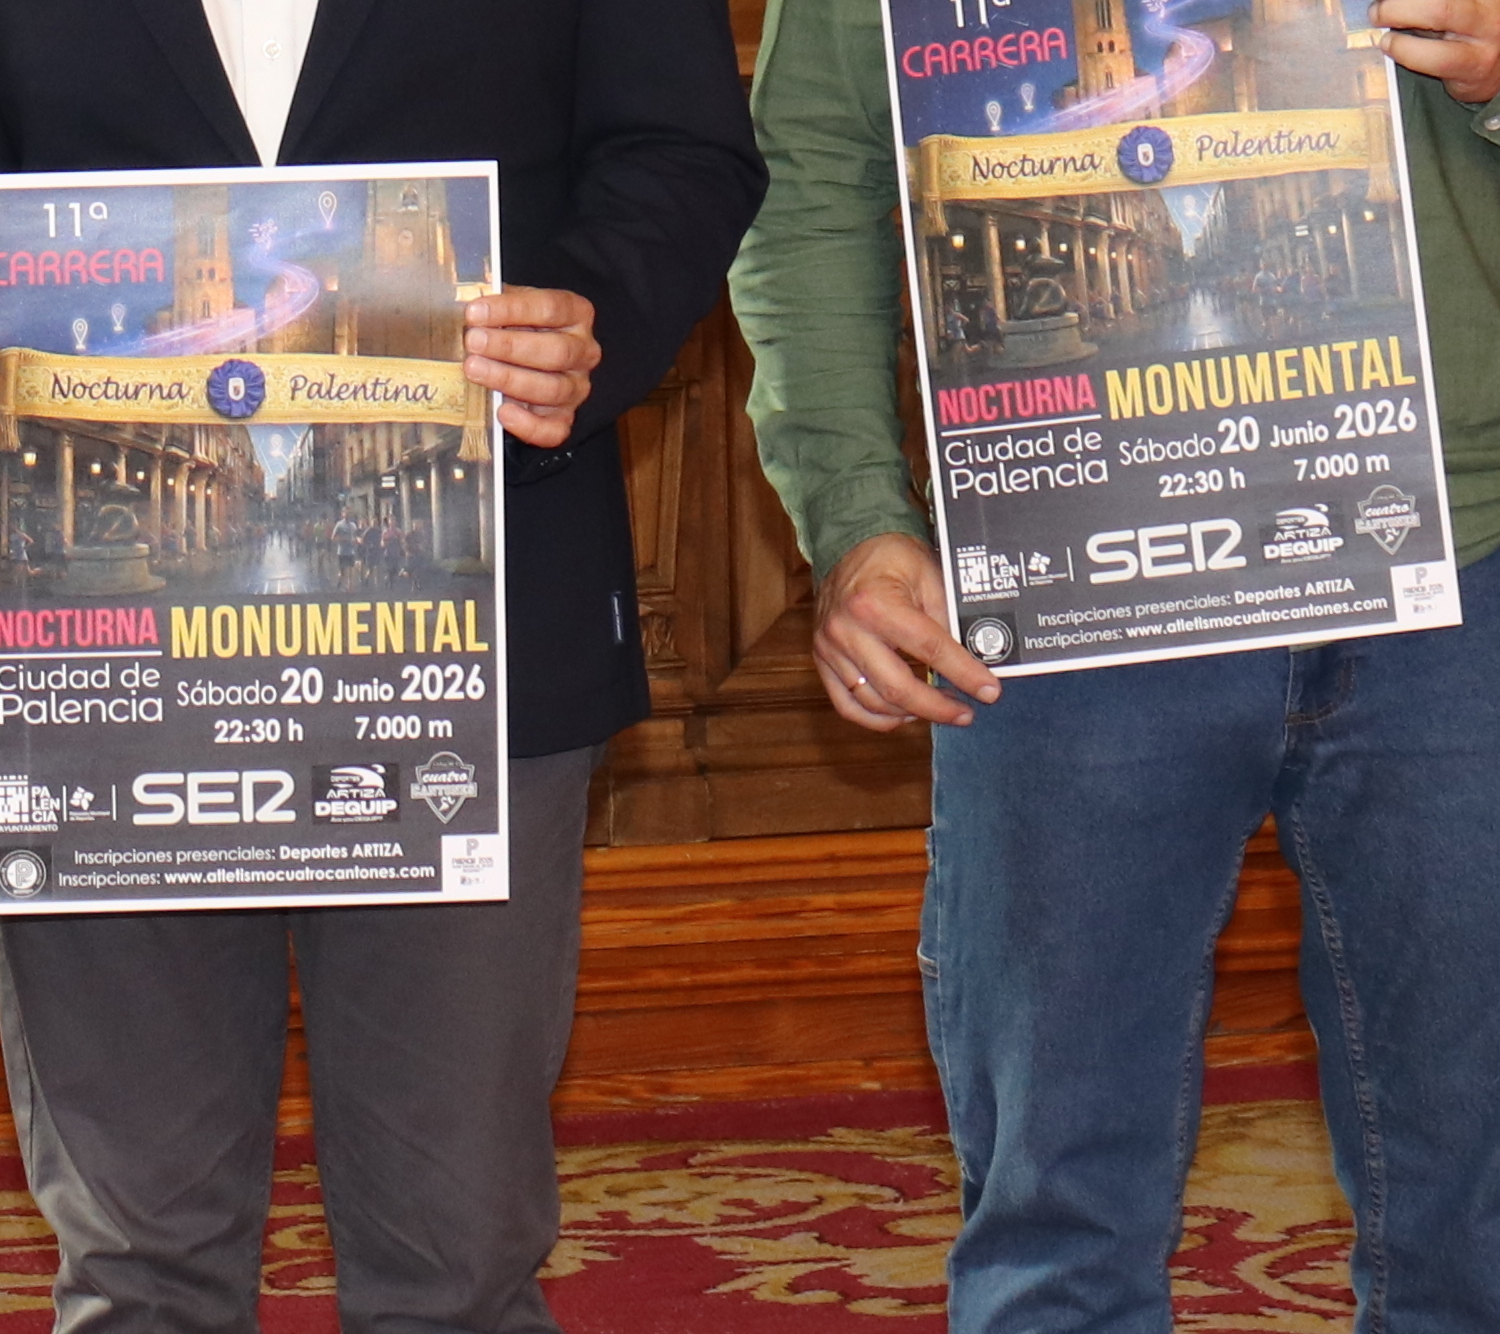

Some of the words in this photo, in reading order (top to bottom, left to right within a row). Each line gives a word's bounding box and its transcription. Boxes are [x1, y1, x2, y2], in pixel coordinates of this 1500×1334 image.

[902, 25, 1066, 77] CARRERA
[971, 153, 1101, 181] Nocturna
[1196, 129, 1339, 161] Palentina
[42, 201, 107, 239] 11ª
[50, 372, 189, 401] Nocturna
[289, 373, 437, 402] Palentina
[935, 374, 1095, 423] NOCTURNA
[1106, 335, 1415, 420] MONUMENTAL
[942, 430, 1054, 466] Ciudad
[1063, 426, 1102, 453] de
[1119, 432, 1215, 465] Sábado
[1217, 415, 1259, 453] 20
[1269, 419, 1329, 447] Junio
[1334, 396, 1416, 440] 2026
[948, 454, 1108, 497] Palencia
[1158, 468, 1223, 498] 22:30
[1228, 466, 1245, 490] h
[1293, 452, 1359, 481] 7.000
[1365, 453, 1390, 473] m
[989, 554, 1009, 567] PA
[1086, 518, 1246, 584] SER
[991, 564, 1019, 579] LEN
[992, 576, 1018, 590] CIA
[962, 589, 1020, 603] AYUNTAMIENTO
[1037, 605, 1131, 627] Inscripciones
[1135, 593, 1231, 618] presenciales:
[1233, 584, 1301, 605] Deportes
[1304, 578, 1356, 596] ARTIZA
[171, 600, 487, 658] MONUMENTAL
[1024, 628, 1123, 650] Inscripciones:
[1125, 596, 1387, 637] www.atletismocuatrocantones.com
[119, 661, 160, 688] de
[176, 679, 276, 706] Sábado
[280, 666, 323, 704] 20
[332, 677, 394, 703] Junio
[400, 663, 484, 701] 2026
[214, 718, 280, 743] 22:30
[287, 717, 303, 741] h
[354, 715, 421, 739] 7.000
[428, 719, 452, 738] m
[132, 770, 295, 825] SER
[314, 799, 397, 816] DEQUIP
[74, 848, 172, 866] Inscripciones
[176, 845, 275, 865] presenciales:
[279, 843, 347, 862] Deportes
[351, 842, 403, 857] ARTIZA
[58, 870, 160, 888] Inscripciones:
[164, 865, 434, 883] www.atletismocuatrocantones.com
